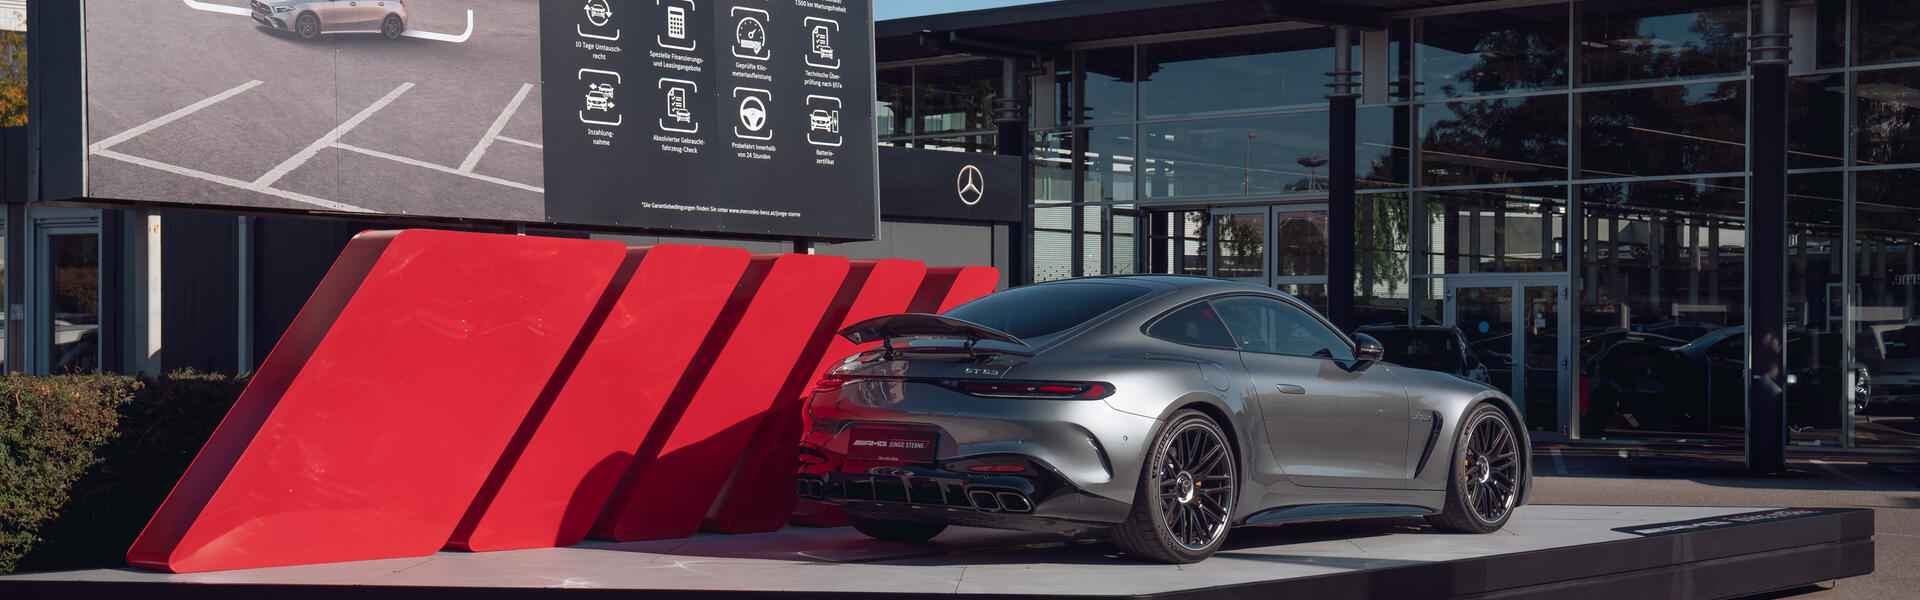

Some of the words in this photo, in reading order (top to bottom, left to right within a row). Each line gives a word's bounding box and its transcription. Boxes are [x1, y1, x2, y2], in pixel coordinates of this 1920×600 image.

[582, 41, 594, 51] Tage
[595, 43, 622, 53] Umtausch-
[649, 50, 671, 59] Spezielle
[671, 53, 704, 64] Finanzierungs-
[663, 61, 701, 72] Leasingangebote
[735, 61, 756, 70] Geprüfte
[731, 71, 772, 82] meterlaufleistung
[805, 69, 829, 79] Technische
[829, 71, 841, 80] Über-
[804, 79, 821, 88] prüfung
[587, 128, 615, 138] Inzahlung-
[592, 138, 610, 146] nahme
[652, 134, 680, 143] Absolvierter
[680, 137, 706, 146] Gebraucht-
[661, 144, 698, 154] fahrzeug-Check
[731, 141, 755, 150] Probefahrt
[755, 143, 776, 152] innerhalb
[753, 152, 771, 160] Stunden
[816, 149, 834, 157] Batterie-
[651, 202, 696, 212] Garantiebedingungen
